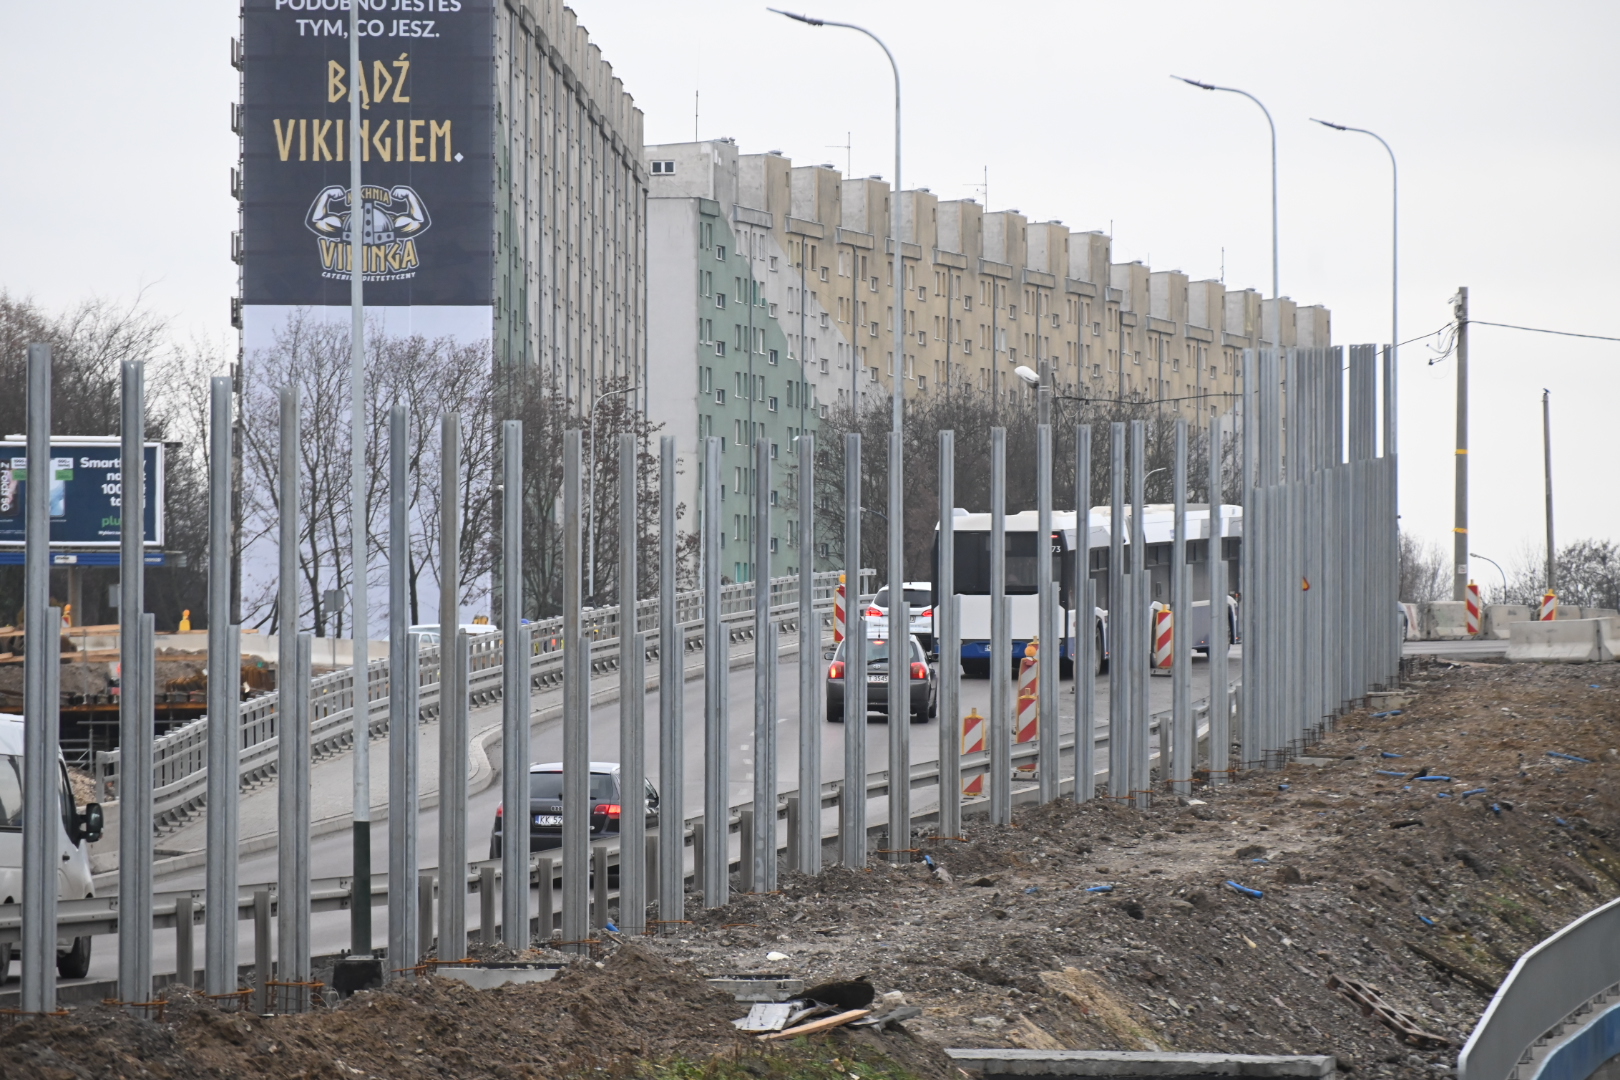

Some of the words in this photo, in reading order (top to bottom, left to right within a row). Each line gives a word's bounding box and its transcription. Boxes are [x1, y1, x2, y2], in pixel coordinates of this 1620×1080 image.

[295, 19, 349, 39] TYM,
[357, 19, 385, 37] CO
[388, 19, 440, 37] JESZ.
[102, 515, 122, 529] plu
[553, 815, 563, 824] 52
